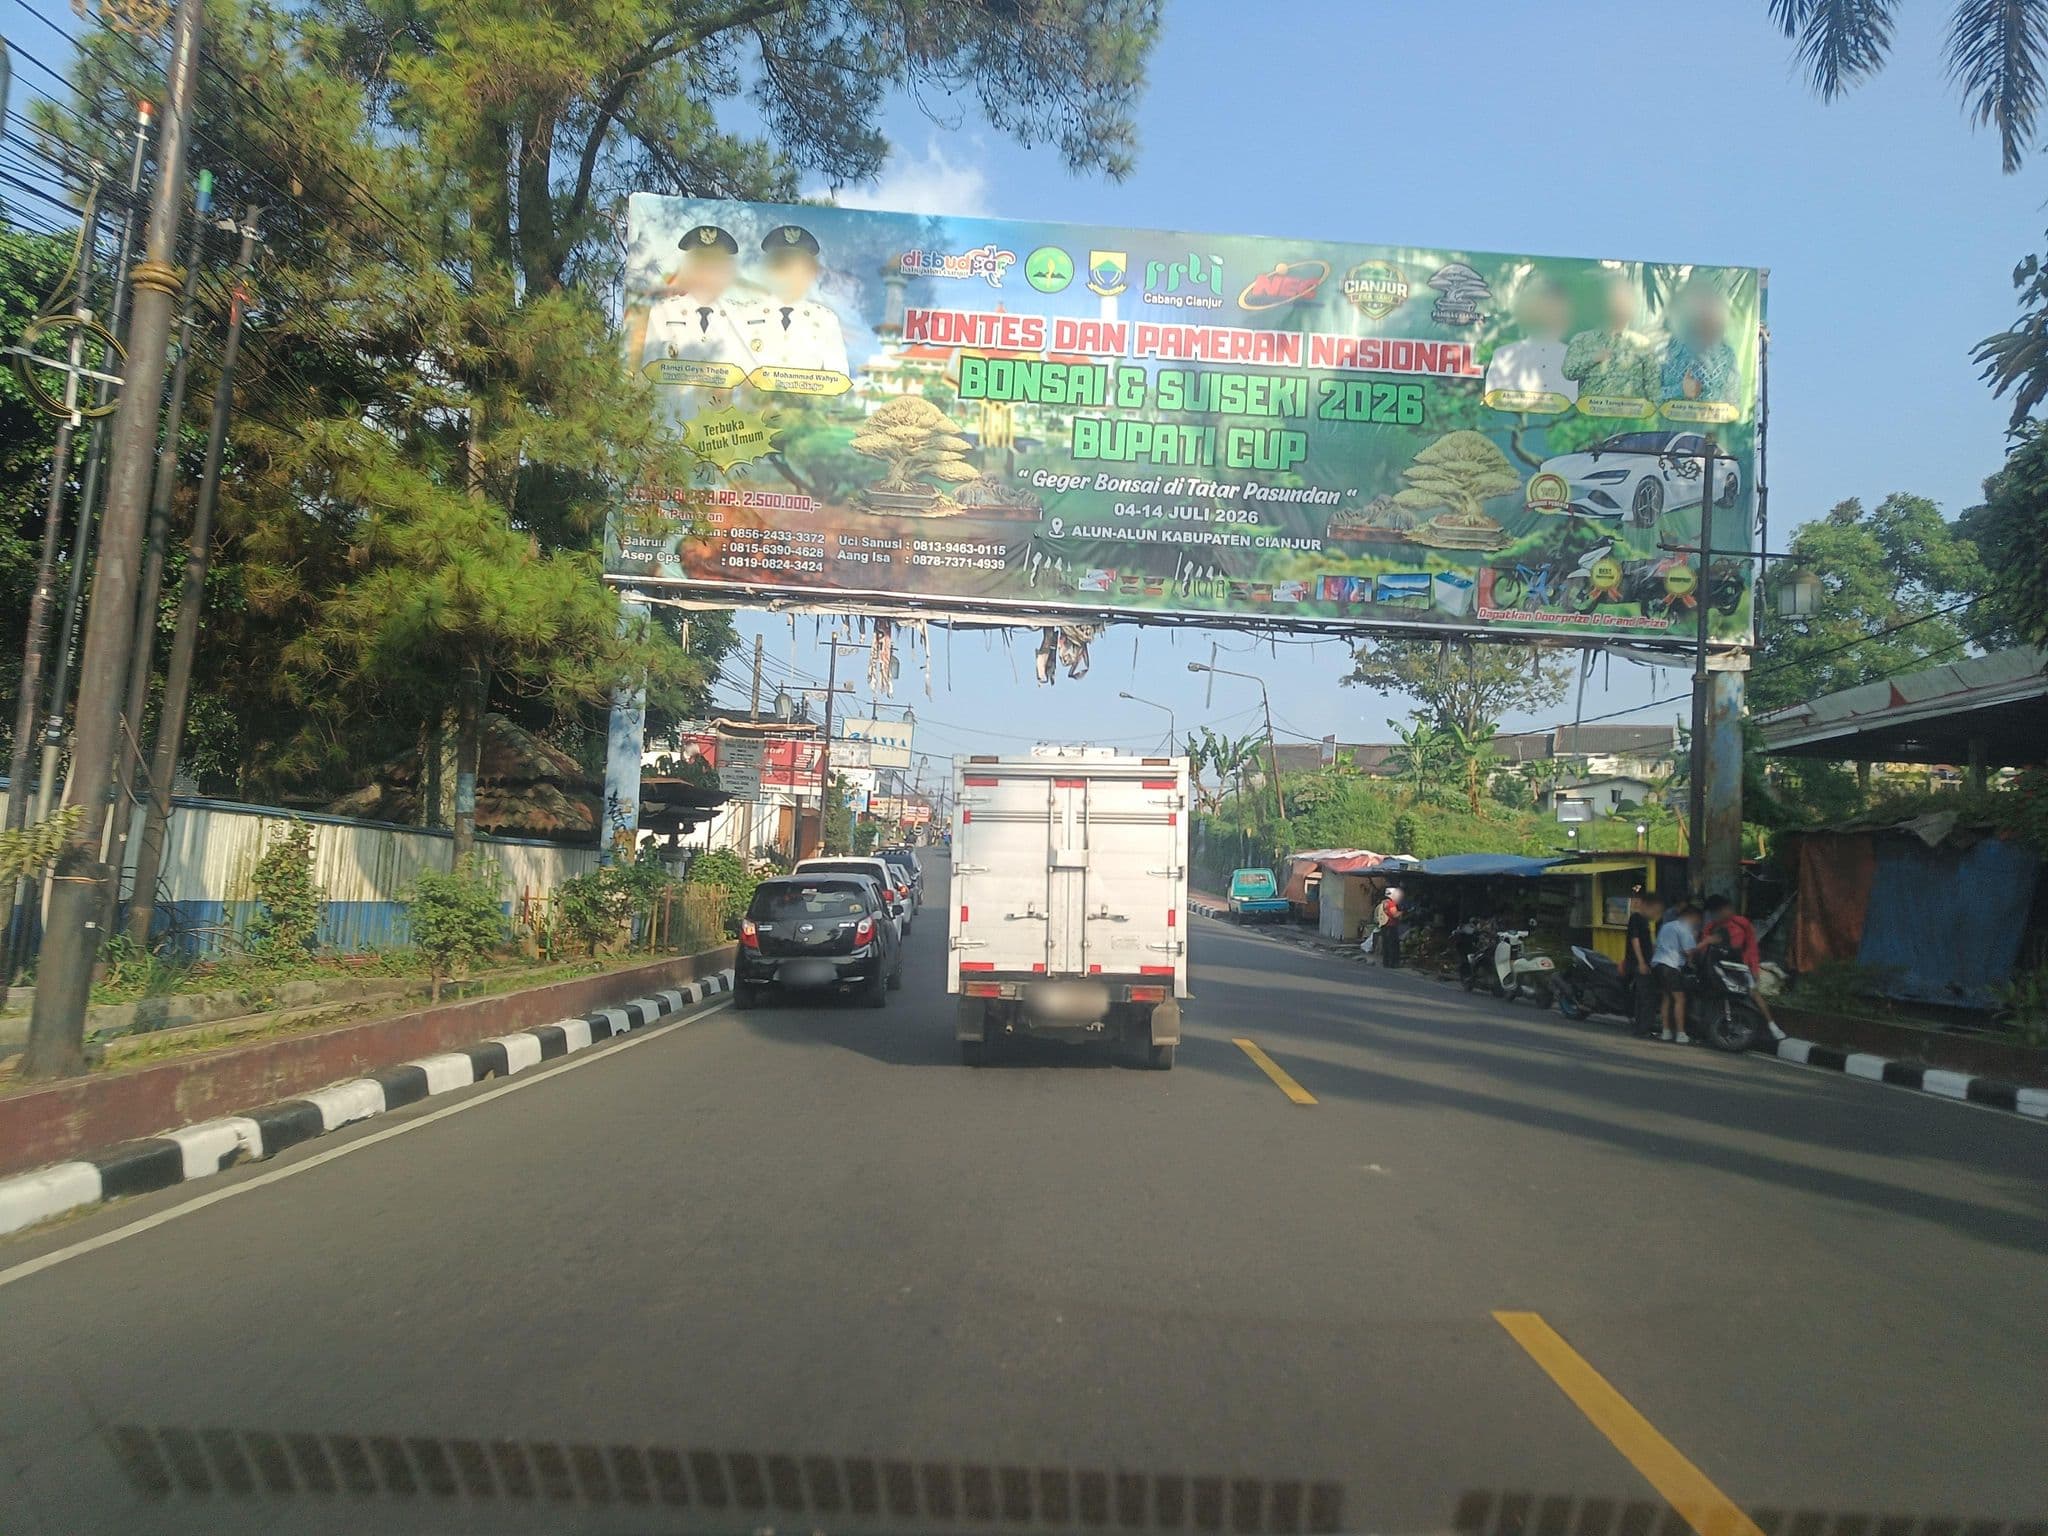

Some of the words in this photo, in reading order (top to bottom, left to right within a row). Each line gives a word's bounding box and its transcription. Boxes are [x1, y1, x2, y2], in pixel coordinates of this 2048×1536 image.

[1344, 279, 1408, 298] CIANJUR
[1144, 292, 1183, 308] Cabang
[1185, 294, 1224, 310] Cianjur
[905, 310, 1045, 349] KONTES
[1054, 319, 1127, 354] DAN
[1136, 324, 1301, 365] PAMERAN
[1311, 334, 1483, 375] NASIONAL
[773, 371, 814, 380] Mohammad
[960, 357, 1107, 406] BONSAI
[1117, 366, 1146, 408] &
[1157, 369, 1309, 418] SUISEKI
[1318, 379, 1425, 425] 2026
[703, 419, 745, 437] Terbuka
[698, 434, 729, 453] Untuk
[731, 430, 764, 446] Umum
[1073, 417, 1217, 467] BUPATI
[1227, 426, 1307, 471] CUP
[1032, 469, 1091, 492] Geger
[1095, 473, 1160, 496] Bonsai
[1163, 477, 1184, 496] di
[1187, 479, 1240, 500] Tatar
[1243, 482, 1341, 505] Pasundan
[719, 490, 741, 507] RP.
[743, 491, 822, 513] 2.500.000,-
[1114, 503, 1163, 519] 04-14
[1166, 505, 1210, 522] JULI
[1214, 508, 1260, 524] 2026
[730, 528, 825, 544] 0856-2433-3372
[838, 535, 858, 547] Uci
[862, 537, 902, 550] Sanusi
[912, 540, 1006, 555] 0813-9463-0115
[1071, 524, 1157, 542] ALUN-ALUN
[1161, 530, 1251, 548] KABUPATEN
[1255, 535, 1322, 551] CIANJUR
[621, 549, 653, 562] Asep
[656, 551, 681, 563] Cps
[728, 557, 823, 572] 0819-0824-3424
[729, 543, 824, 558] 0815-6390-4628
[837, 550, 869, 563] Aang
[872, 552, 890, 563] Isa
[912, 555, 1005, 569] 0878-7371-4939
[1478, 607, 1532, 622] Dapatkan
[1535, 610, 1589, 625] Doorprize
[1603, 614, 1636, 627] Grand
[1638, 616, 1668, 629] Prize
